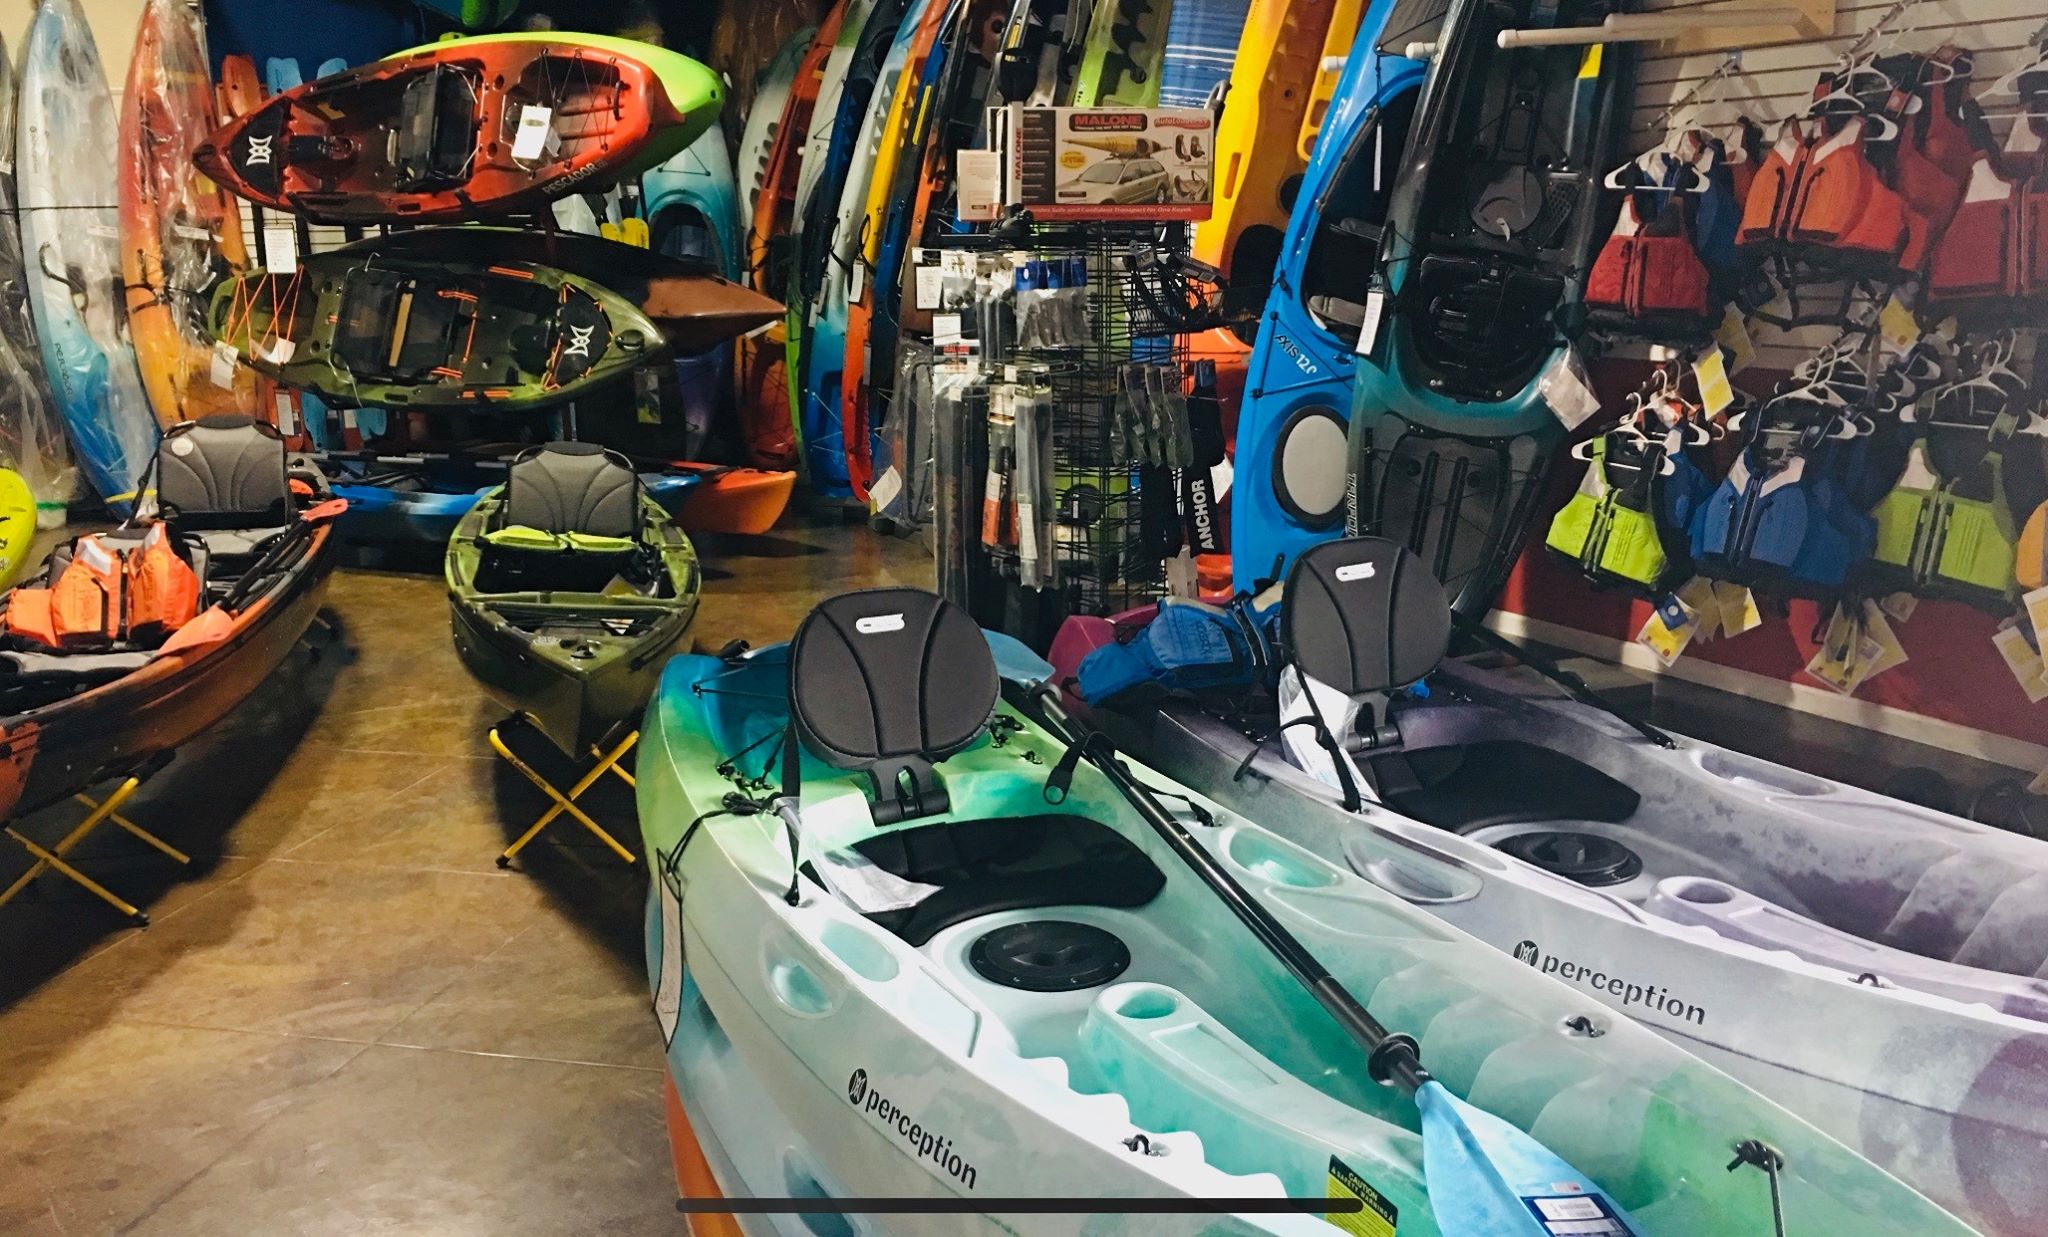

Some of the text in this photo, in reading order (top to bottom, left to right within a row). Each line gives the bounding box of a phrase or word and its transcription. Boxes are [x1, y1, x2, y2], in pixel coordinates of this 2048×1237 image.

[1074, 115, 1143, 125] MALONE
[541, 162, 599, 194] PESCADOR
[1015, 127, 1023, 180] MALONE
[1275, 335, 1299, 358] AXIS
[1191, 479, 1215, 550] ANCHOR
[1541, 954, 1706, 1026] perception
[865, 1088, 977, 1190] perception
[1336, 1170, 1389, 1219] SAFETY WARNING
[1347, 1172, 1379, 1202] CAUTION
